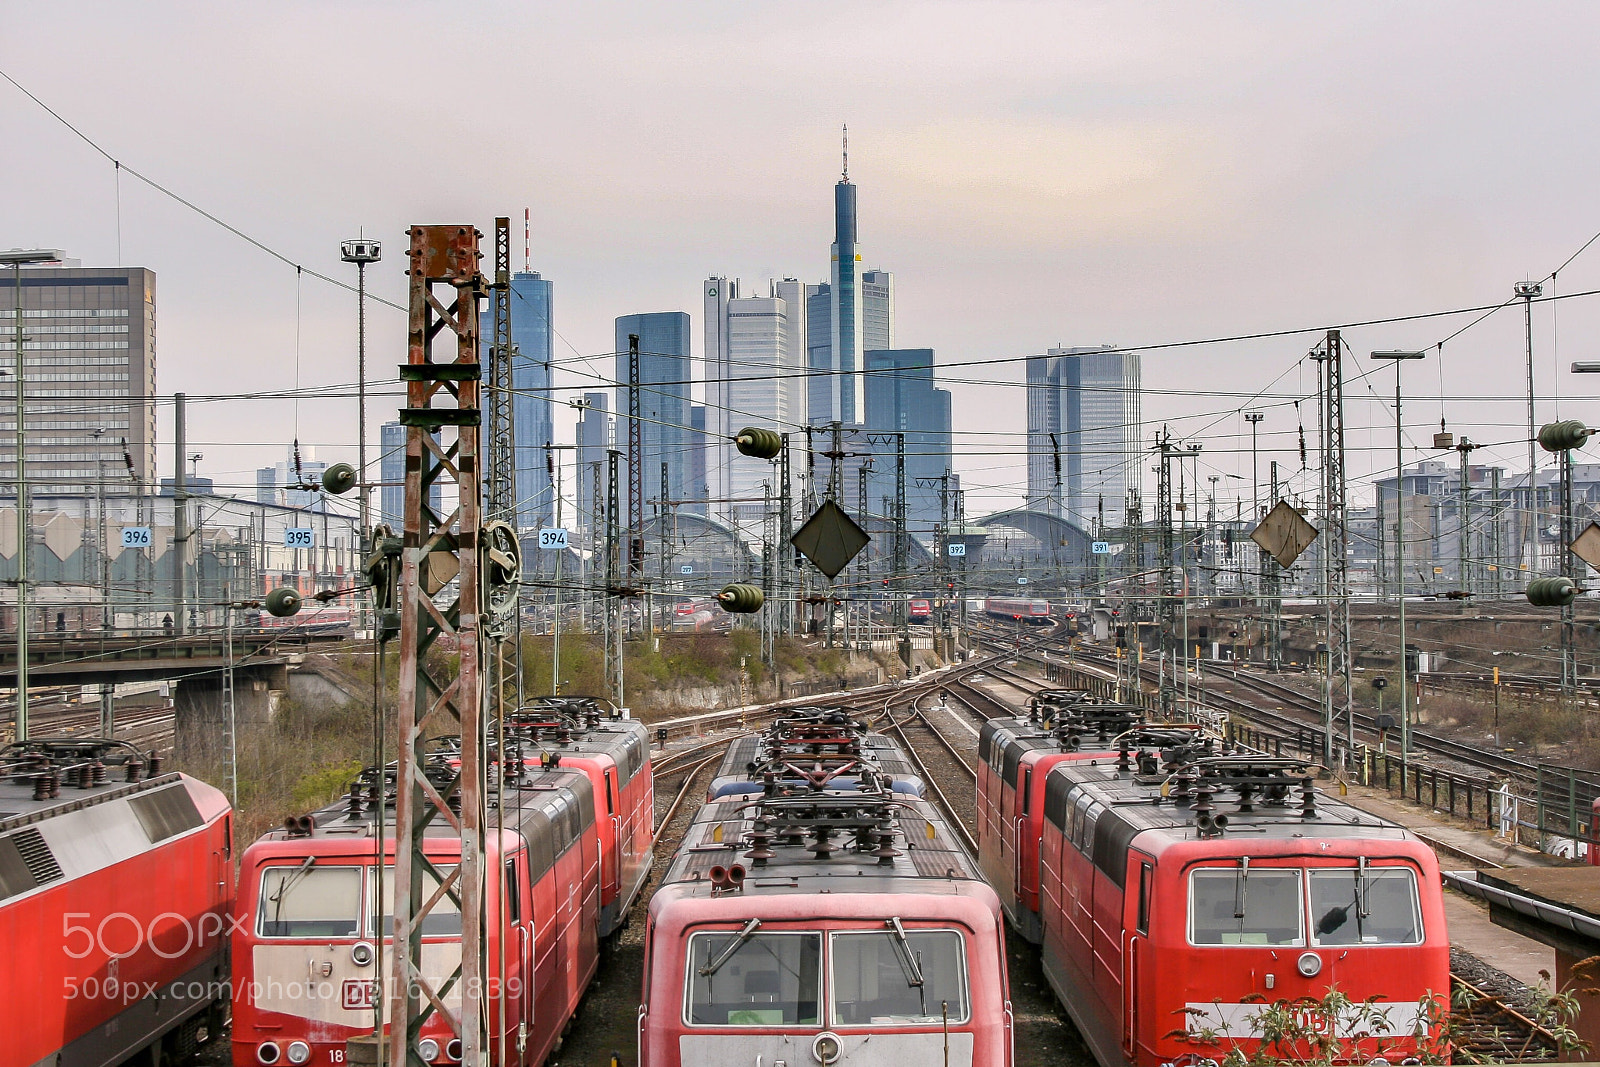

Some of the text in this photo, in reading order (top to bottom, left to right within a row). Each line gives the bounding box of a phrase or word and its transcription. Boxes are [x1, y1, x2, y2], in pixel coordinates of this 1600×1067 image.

[124, 531, 148, 544] 396
[287, 531, 311, 544] 395
[541, 532, 565, 545] 394
[950, 546, 964, 554] 392
[1094, 544, 1107, 552] 391
[329, 1049, 347, 1063] 18
